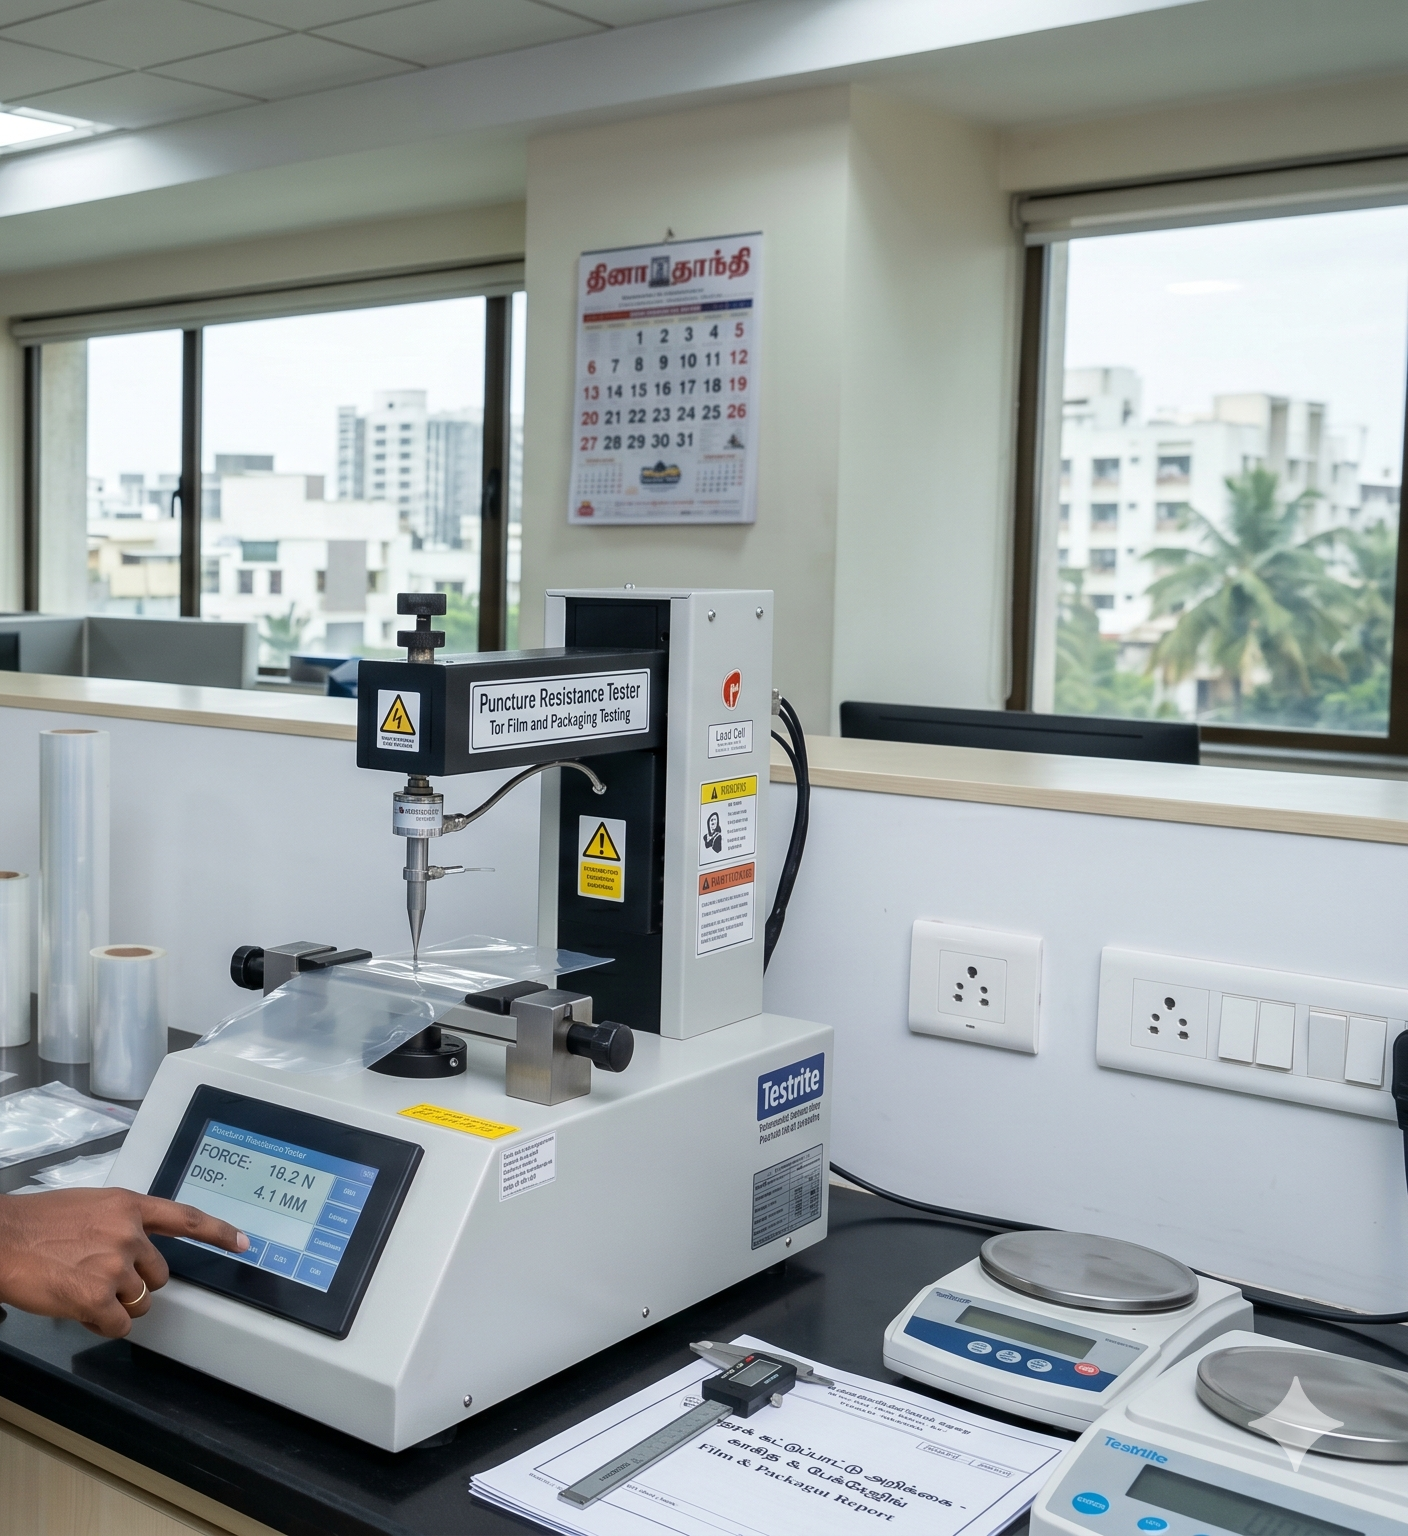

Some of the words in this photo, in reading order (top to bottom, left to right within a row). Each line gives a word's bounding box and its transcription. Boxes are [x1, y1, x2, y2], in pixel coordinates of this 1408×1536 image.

[637, 331, 642, 344] 1
[660, 329, 668, 343] 2
[684, 327, 694, 341] 3
[709, 325, 718, 339] 4
[735, 323, 744, 337] 5
[588, 360, 596, 374] 6
[612, 359, 620, 372] 7
[635, 357, 643, 371] 8
[659, 356, 668, 370] 9
[680, 354, 696, 368] 10
[706, 352, 720, 366] 11
[730, 350, 748, 364] 12
[584, 386, 599, 400] 13
[607, 385, 622, 398] 14
[631, 383, 647, 397] 15
[655, 382, 671, 396] 16
[680, 380, 696, 394] 17
[704, 378, 721, 392] 18
[730, 377, 747, 391] 19
[582, 412, 598, 425] 20
[605, 410, 620, 424] 21
[628, 410, 646, 423] 22
[652, 408, 670, 422] 23
[677, 407, 695, 421] 24
[702, 405, 721, 419] 25
[727, 404, 746, 418] 26
[580, 437, 598, 450] 27
[604, 436, 621, 449] 28
[627, 435, 645, 448] 29
[651, 434, 670, 448] 30
[676, 432, 693, 447] 31
[480, 692, 536, 714] Puncture
[540, 687, 604, 707] Resistance
[607, 682, 640, 701] Tester
[508, 718, 528, 733] Film
[531, 715, 548, 731] and
[551, 711, 597, 730] Packaging
[600, 707, 631, 724] Testing
[762, 1067, 820, 1110] Testrite
[199, 1143, 252, 1170] FORCE:
[301, 1174, 316, 1190] N
[191, 1164, 227, 1187] DISP:
[278, 1192, 308, 1213] MM
[786, 1460, 801, 1470] &
[697, 1443, 734, 1461] Film
[737, 1458, 752, 1468] &
[833, 1494, 895, 1523] Report
